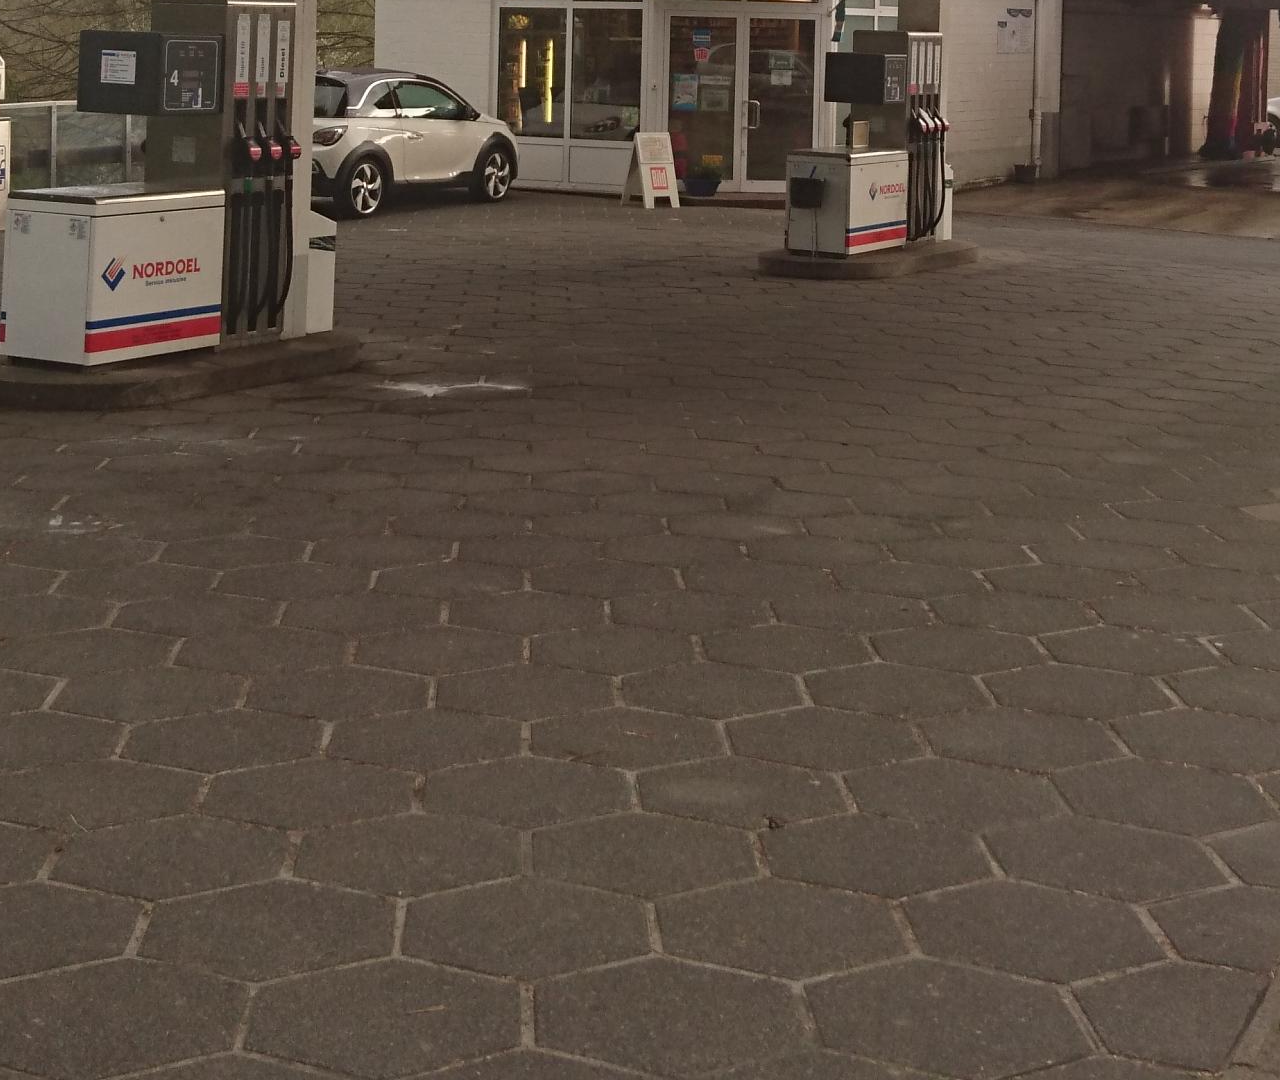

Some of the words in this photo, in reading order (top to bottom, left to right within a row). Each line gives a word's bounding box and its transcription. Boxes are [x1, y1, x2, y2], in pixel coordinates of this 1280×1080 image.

[170, 69, 179, 87] 4
[879, 182, 906, 195] NORDOEL
[132, 257, 200, 280] NORDOEL
